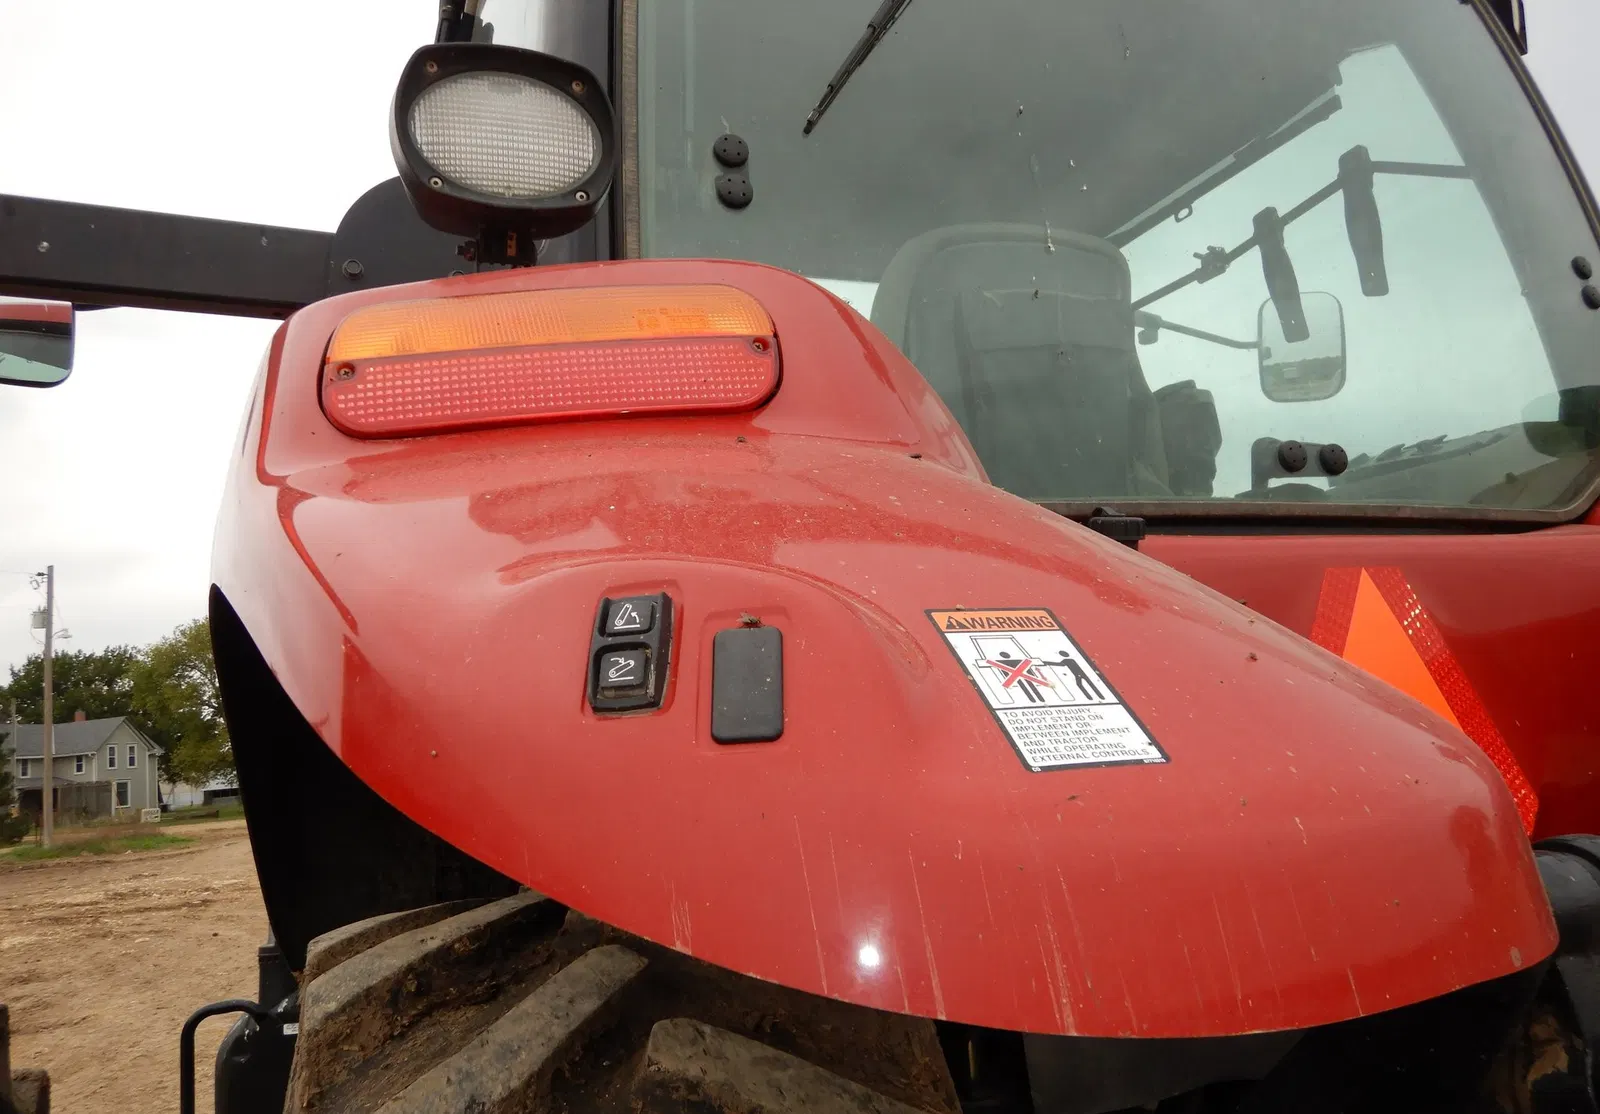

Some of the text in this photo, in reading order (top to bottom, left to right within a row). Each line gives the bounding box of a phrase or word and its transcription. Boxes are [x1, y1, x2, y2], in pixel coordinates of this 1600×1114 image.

[963, 615, 1056, 629] WARNING
[1021, 709, 1053, 717] AVOID
[1007, 718, 1024, 726] DO
[1050, 714, 1086, 723] STAND
[1012, 722, 1074, 733] IMPLEMENT
[1017, 727, 1131, 740] BETWEEN IMPLEMENT
[1023, 736, 1099, 747] AND TRACTOR
[1026, 742, 1127, 755] WHILE OPERATING
[1032, 752, 1090, 763] EXTERNAL
